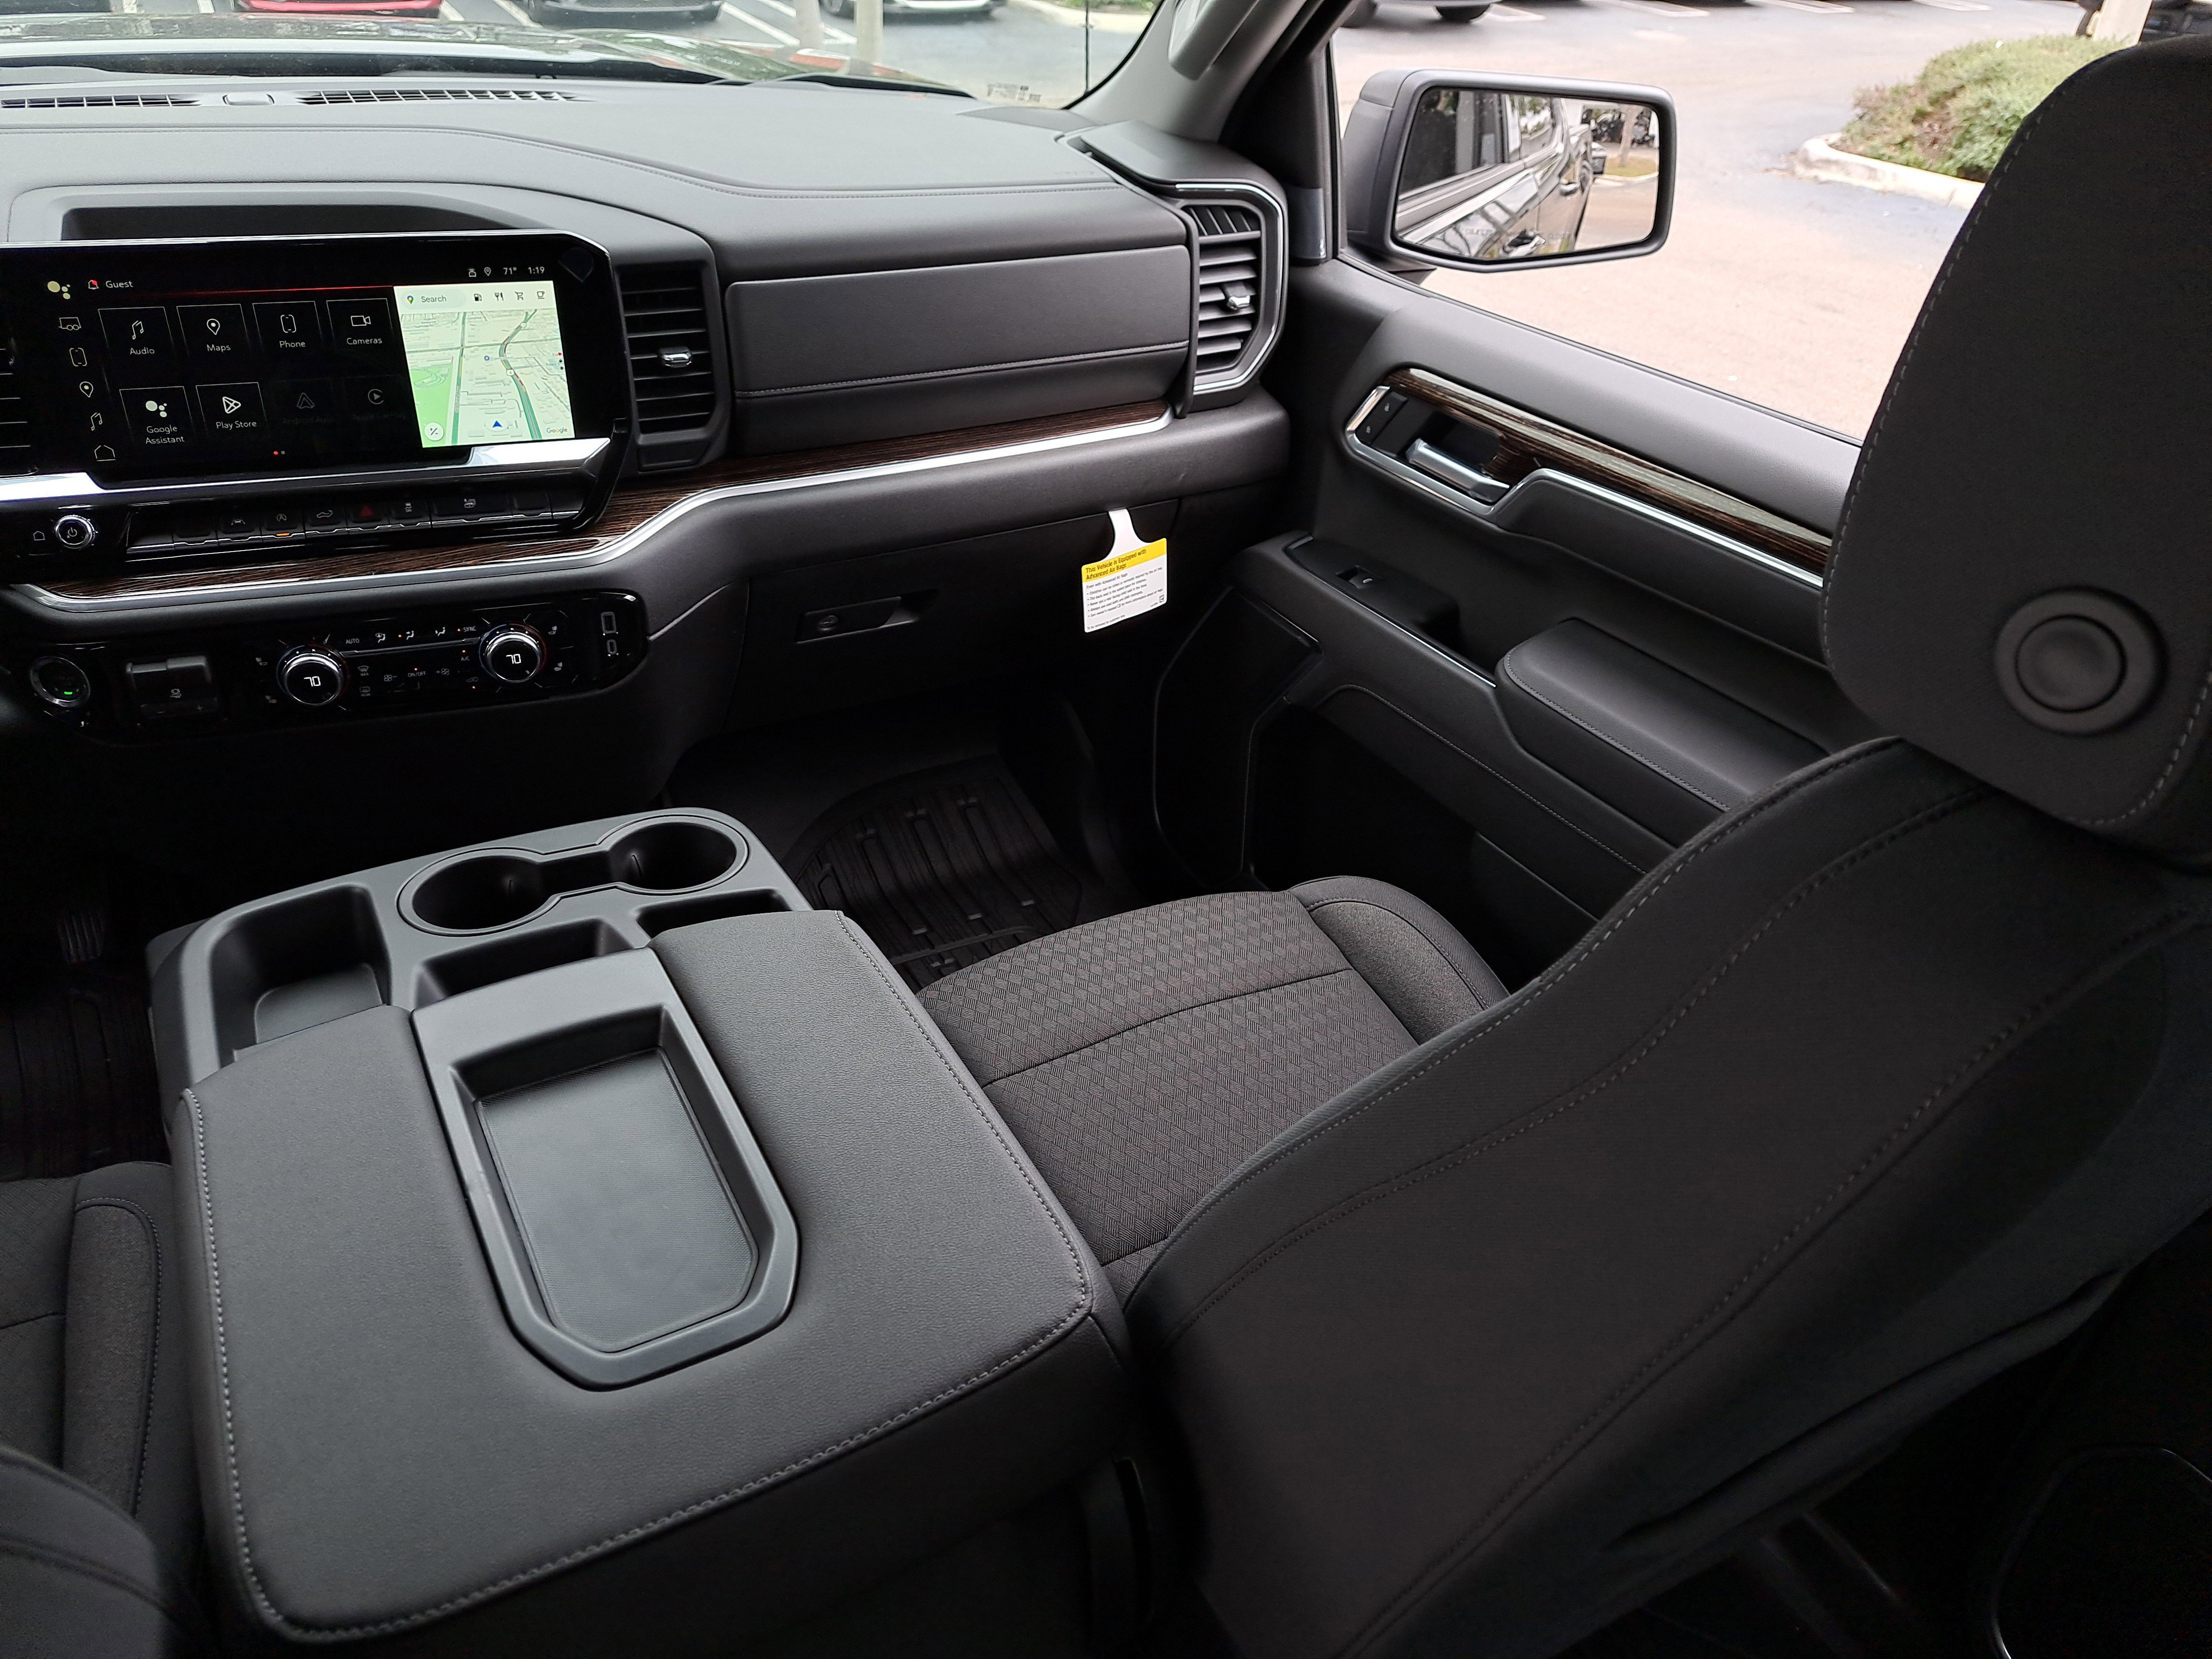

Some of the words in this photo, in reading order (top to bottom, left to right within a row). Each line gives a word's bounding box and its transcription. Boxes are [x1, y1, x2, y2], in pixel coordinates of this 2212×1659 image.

[528, 266, 545, 275] 1:19
[105, 280, 133, 288] Guest
[421, 294, 447, 303] Search
[279, 340, 306, 348] Phone
[346, 336, 383, 345] Cameras
[130, 346, 155, 355] Audio
[207, 343, 231, 353] Maps
[146, 424, 178, 434] Google
[216, 420, 233, 430] Play
[236, 419, 257, 428] Store
[546, 426, 568, 435] Google
[145, 435, 185, 444] Assistant
[1097, 562, 1113, 570] Vehicle
[1118, 553, 1137, 564] Equipped
[1086, 569, 1108, 580] Advanced
[506, 653, 521, 665] 70
[304, 676, 321, 687] 70
